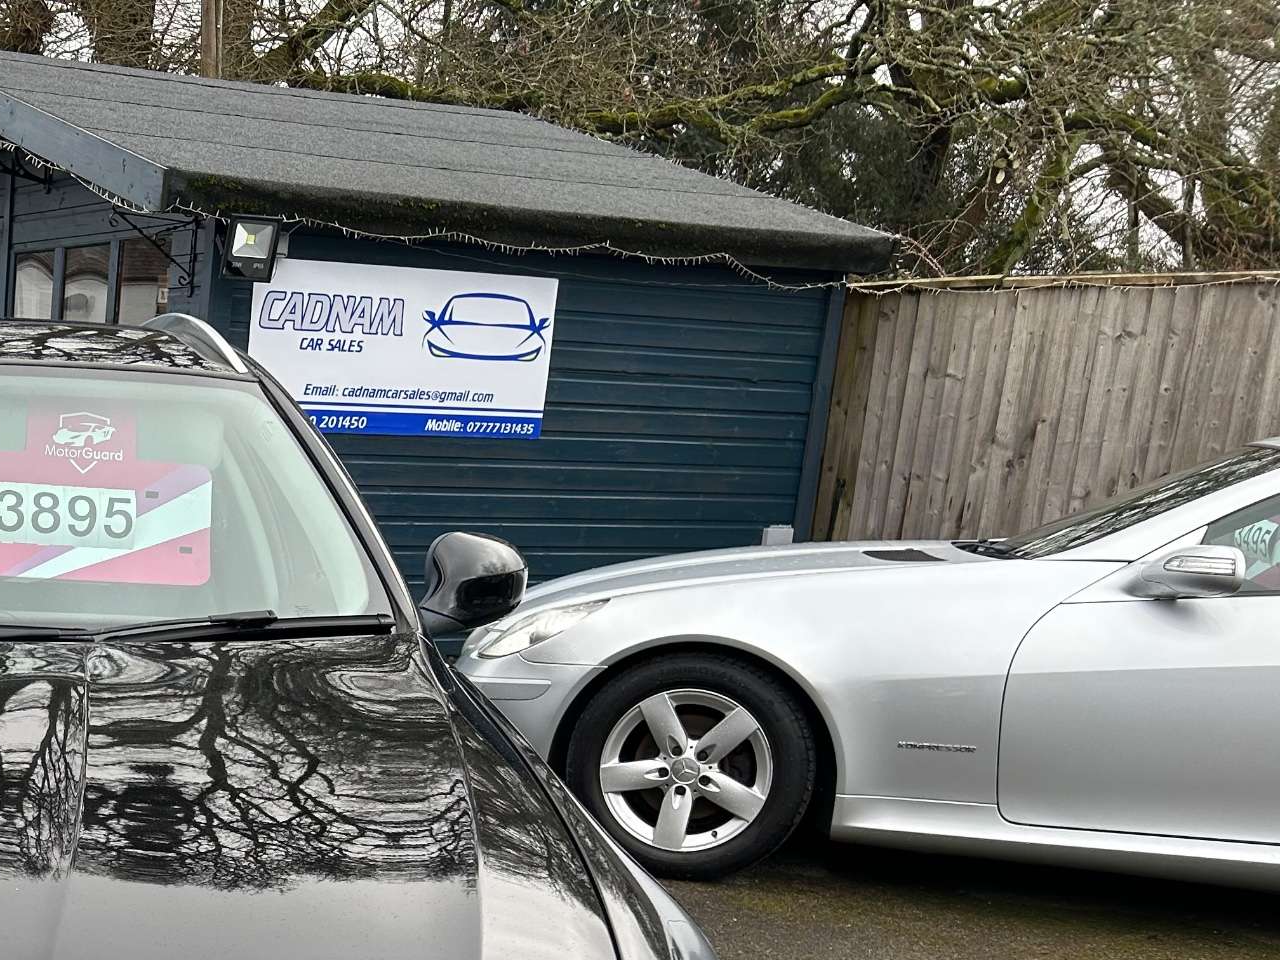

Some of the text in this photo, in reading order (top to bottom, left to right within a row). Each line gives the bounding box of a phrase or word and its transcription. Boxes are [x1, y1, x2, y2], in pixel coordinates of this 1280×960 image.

[259, 290, 405, 336] CADNAM
[299, 337, 364, 353] CAR SALES
[303, 383, 494, 403] Email: cadnamcarsales@gmail.com
[319, 416, 368, 429] 201450
[425, 419, 534, 434] Mobile: 07777131435
[44, 444, 123, 462] MotorGuard
